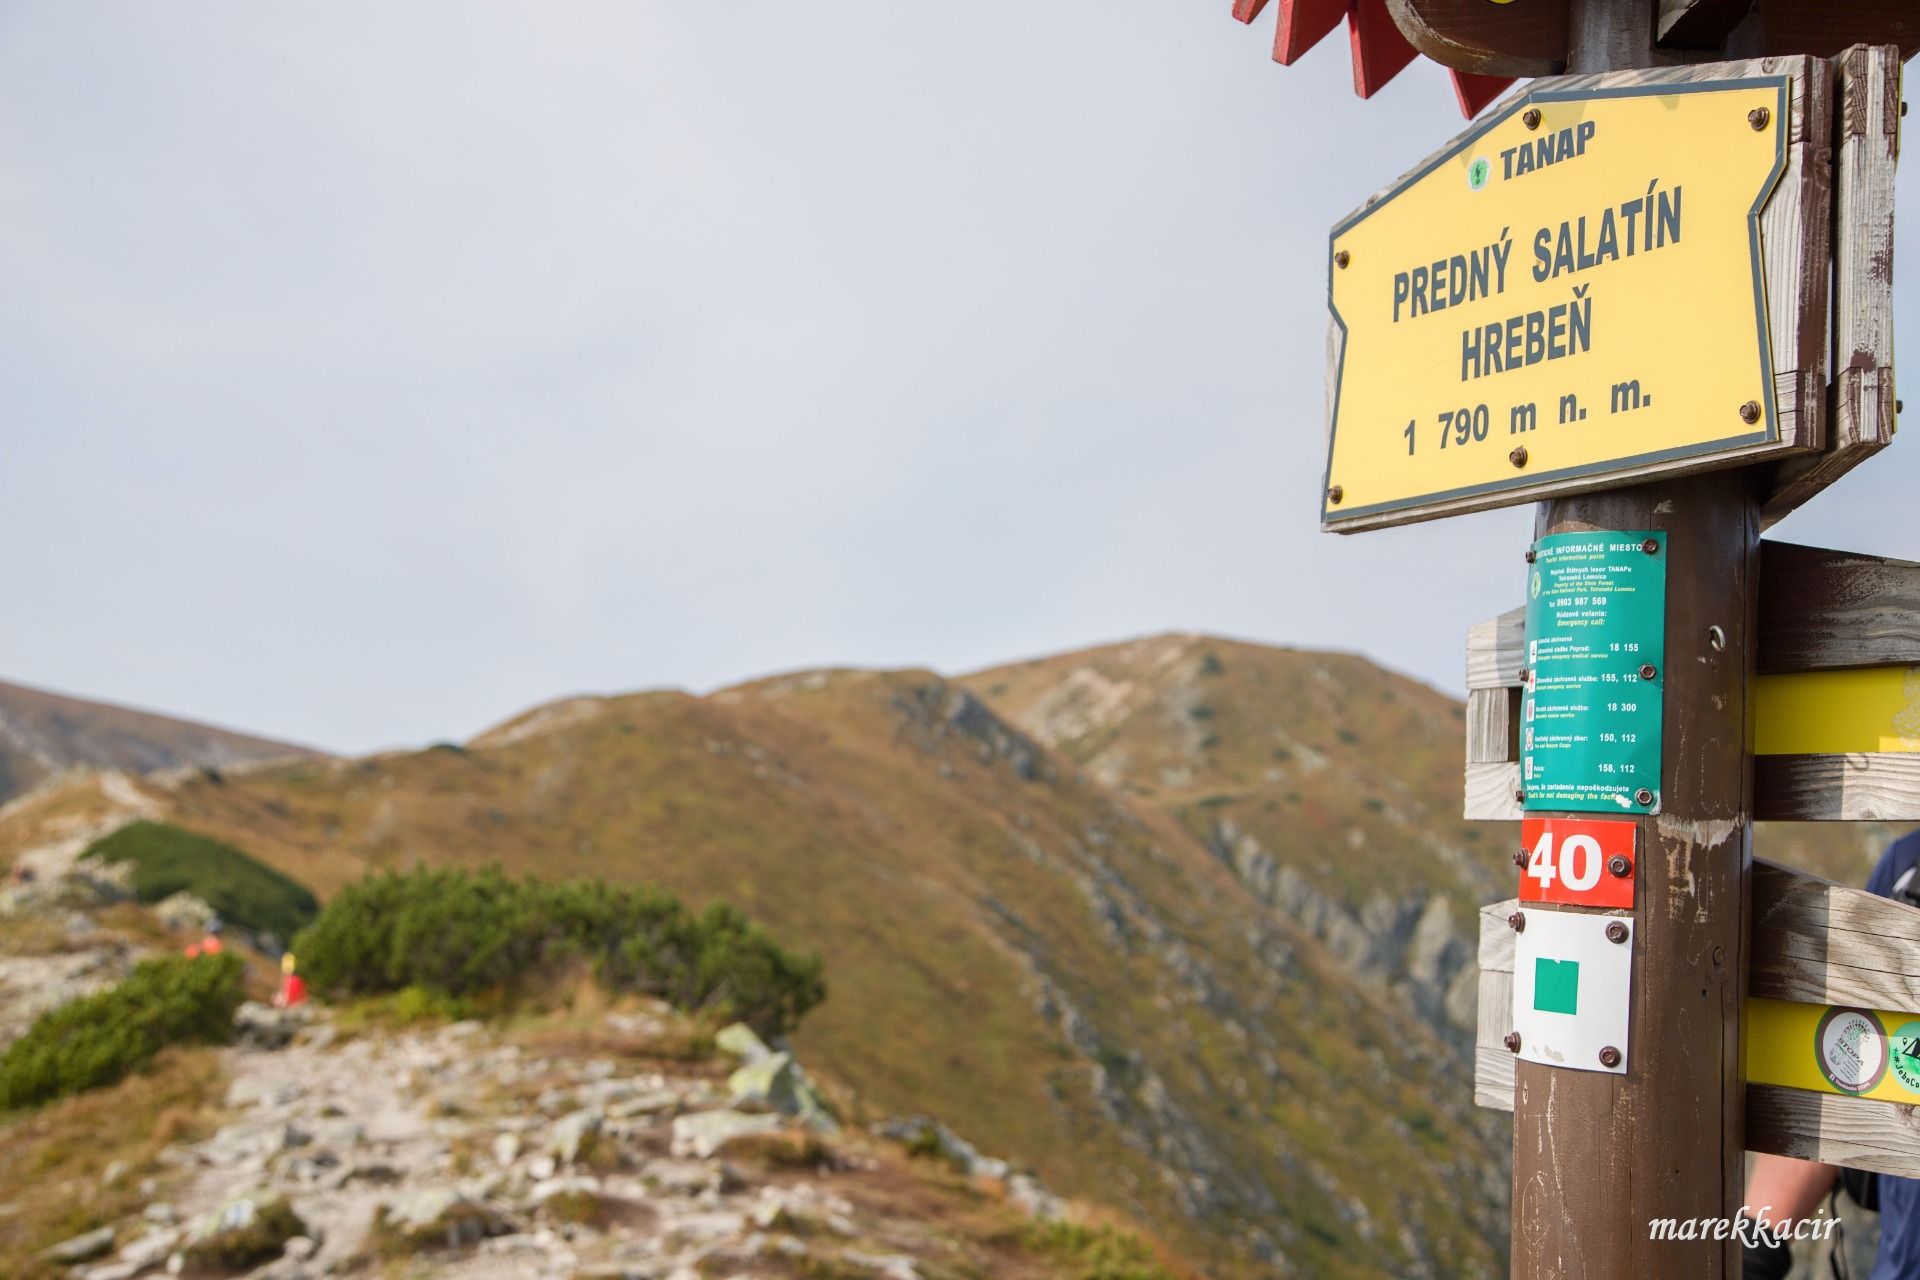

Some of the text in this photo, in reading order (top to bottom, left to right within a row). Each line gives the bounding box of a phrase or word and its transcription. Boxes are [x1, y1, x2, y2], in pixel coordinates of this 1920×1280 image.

[1500, 120, 1595, 181] TANAP
[1393, 179, 1682, 322] PREDNÝ SALATÍN
[1461, 284, 1592, 381] HREBEŇ
[1404, 377, 1651, 455] 1 790 m n. m.
[1556, 543, 1604, 554] INFORMAČNÉ
[1610, 544, 1642, 552] MIESTO
[1556, 598, 1572, 607] 0903
[1574, 597, 1588, 606] 987
[1592, 596, 1606, 605] 569
[1557, 619, 1588, 628] Emergency
[1610, 644, 1620, 652] 18
[1624, 644, 1639, 652] 155
[1601, 674, 1618, 683] 155,
[1622, 674, 1638, 682] 112
[1608, 703, 1618, 712] 18
[1621, 704, 1636, 712] 300
[1600, 734, 1617, 742] 150,
[1622, 734, 1636, 742] 112
[1598, 764, 1635, 773] 158, 112
[1577, 784, 1630, 793] nepoškodzujete
[1556, 792, 1584, 800] damaging
[1527, 832, 1602, 891] 40
[1837, 1037, 1864, 1067] STOPA
